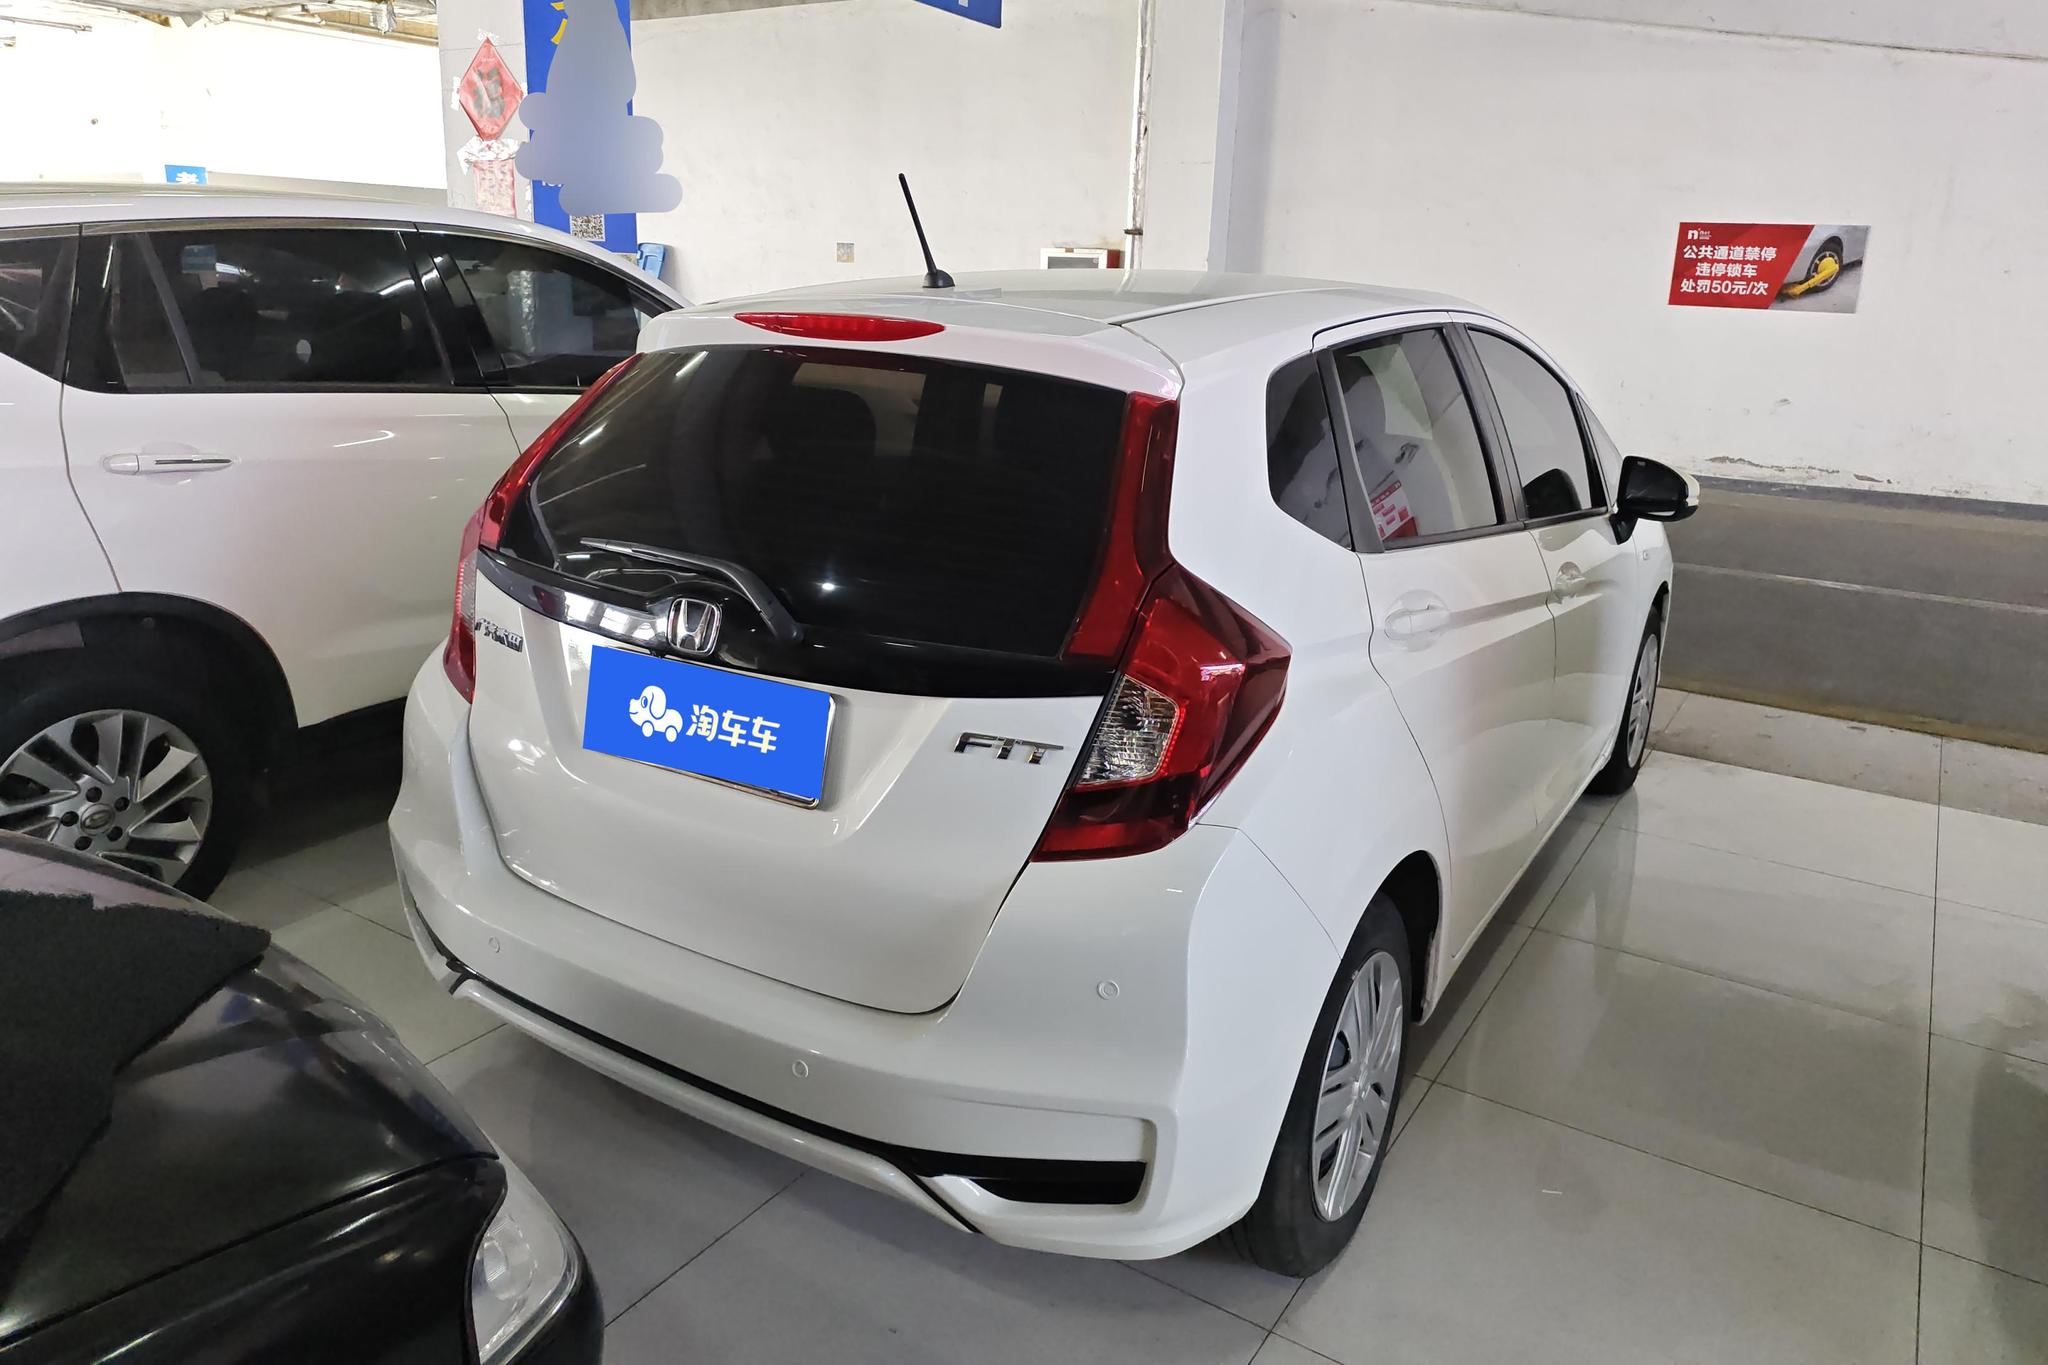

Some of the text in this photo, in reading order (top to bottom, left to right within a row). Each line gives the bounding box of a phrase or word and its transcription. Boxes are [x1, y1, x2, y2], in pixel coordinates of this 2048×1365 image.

[1683, 245, 1777, 262] 公共通道禁停
[1695, 262, 1758, 278] 违停锁车
[1680, 278, 1769, 296] 处罚50元/次
[954, 731, 1064, 765] FIT
